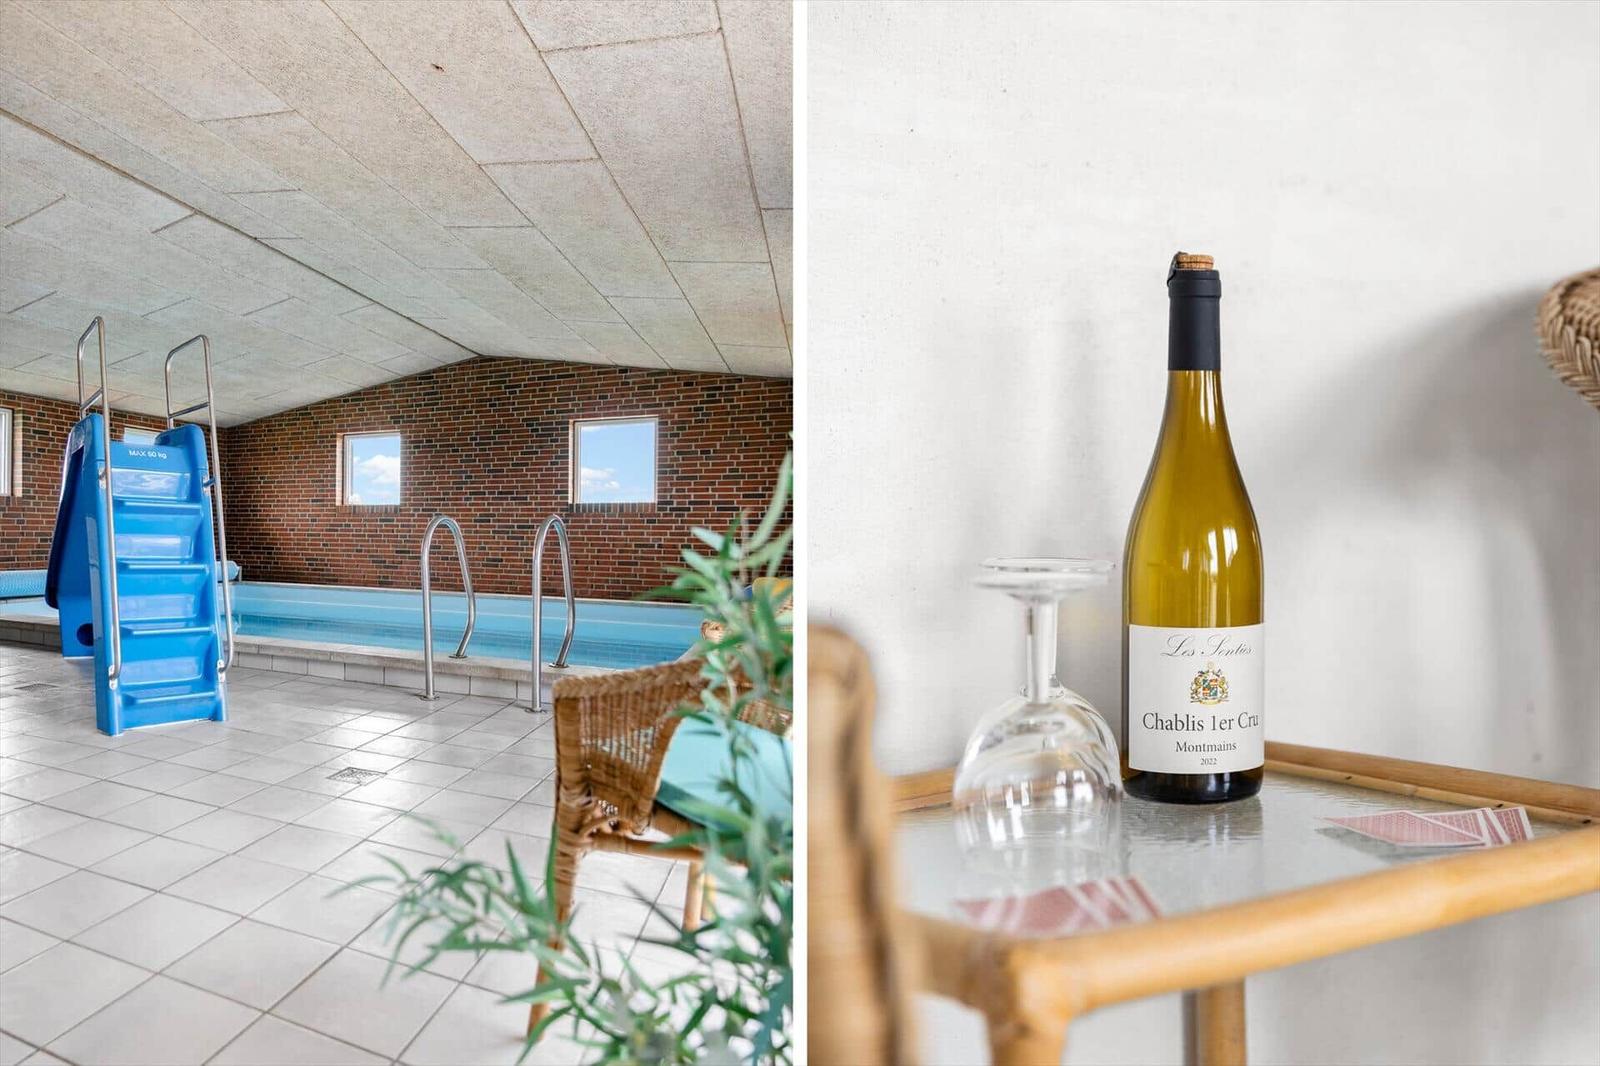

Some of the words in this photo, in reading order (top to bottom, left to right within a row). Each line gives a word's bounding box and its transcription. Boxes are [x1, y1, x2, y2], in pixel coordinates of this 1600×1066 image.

[1160, 633, 1195, 656] Les
[1142, 712, 1204, 732] Chablis
[1211, 715, 1234, 731] 1er
[1237, 711, 1259, 729] Cru
[1175, 740, 1237, 753] Montmains
[1200, 757, 1218, 766] 2022
